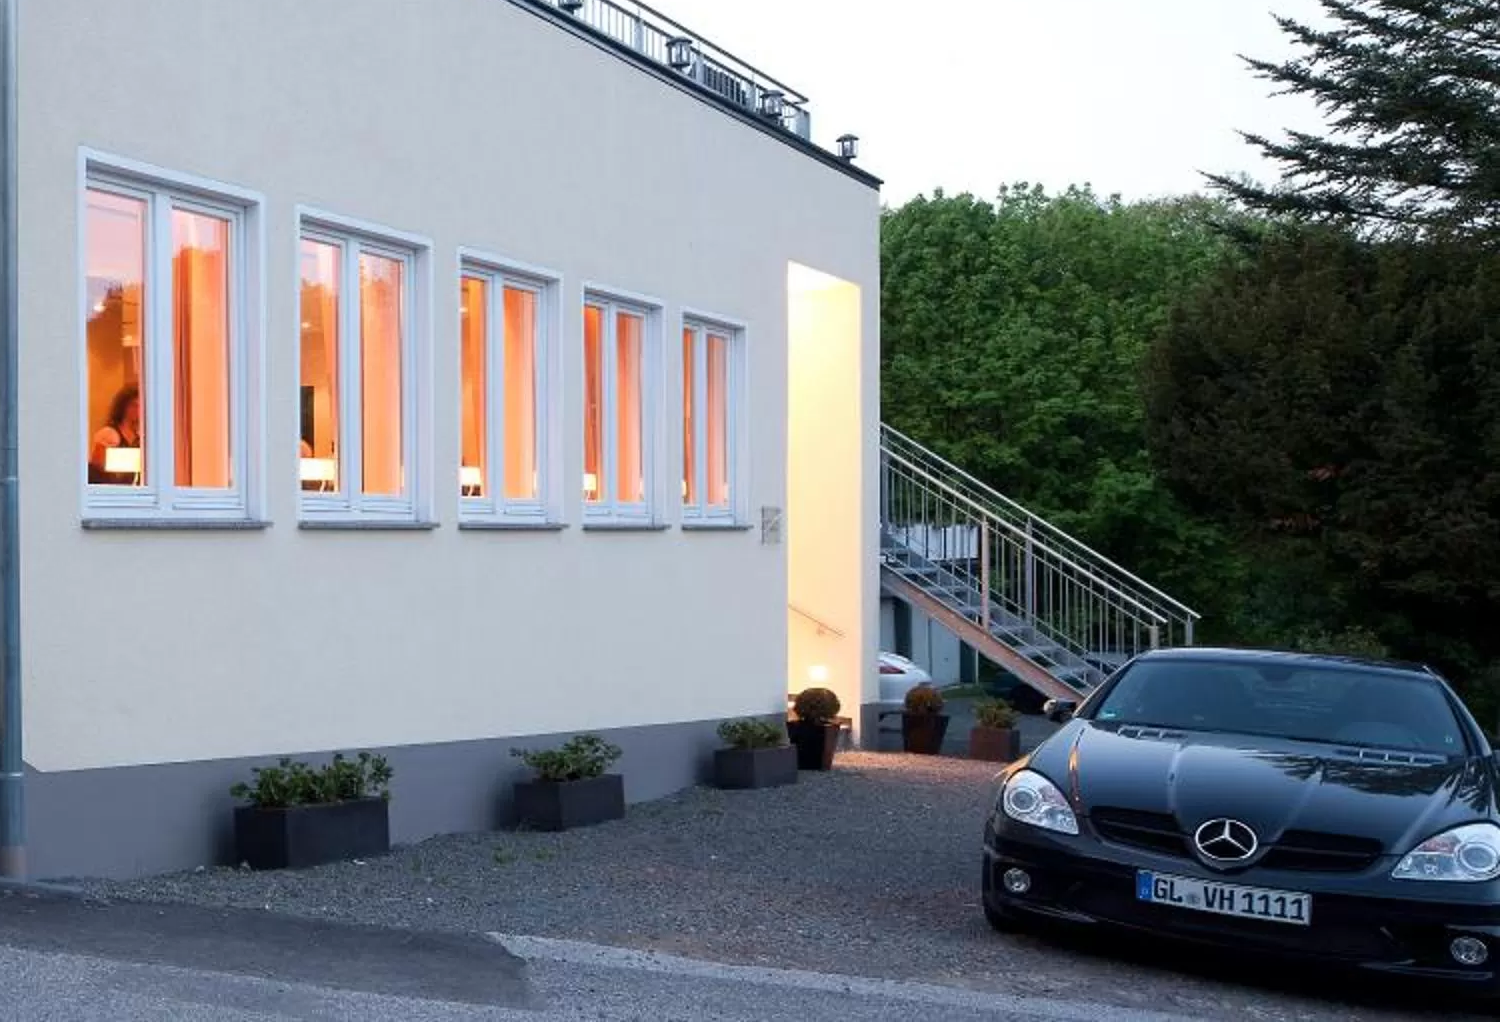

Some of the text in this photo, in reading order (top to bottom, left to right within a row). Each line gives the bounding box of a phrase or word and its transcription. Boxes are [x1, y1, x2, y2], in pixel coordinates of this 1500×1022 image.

[1154, 879, 1305, 920] GL VH 1111
